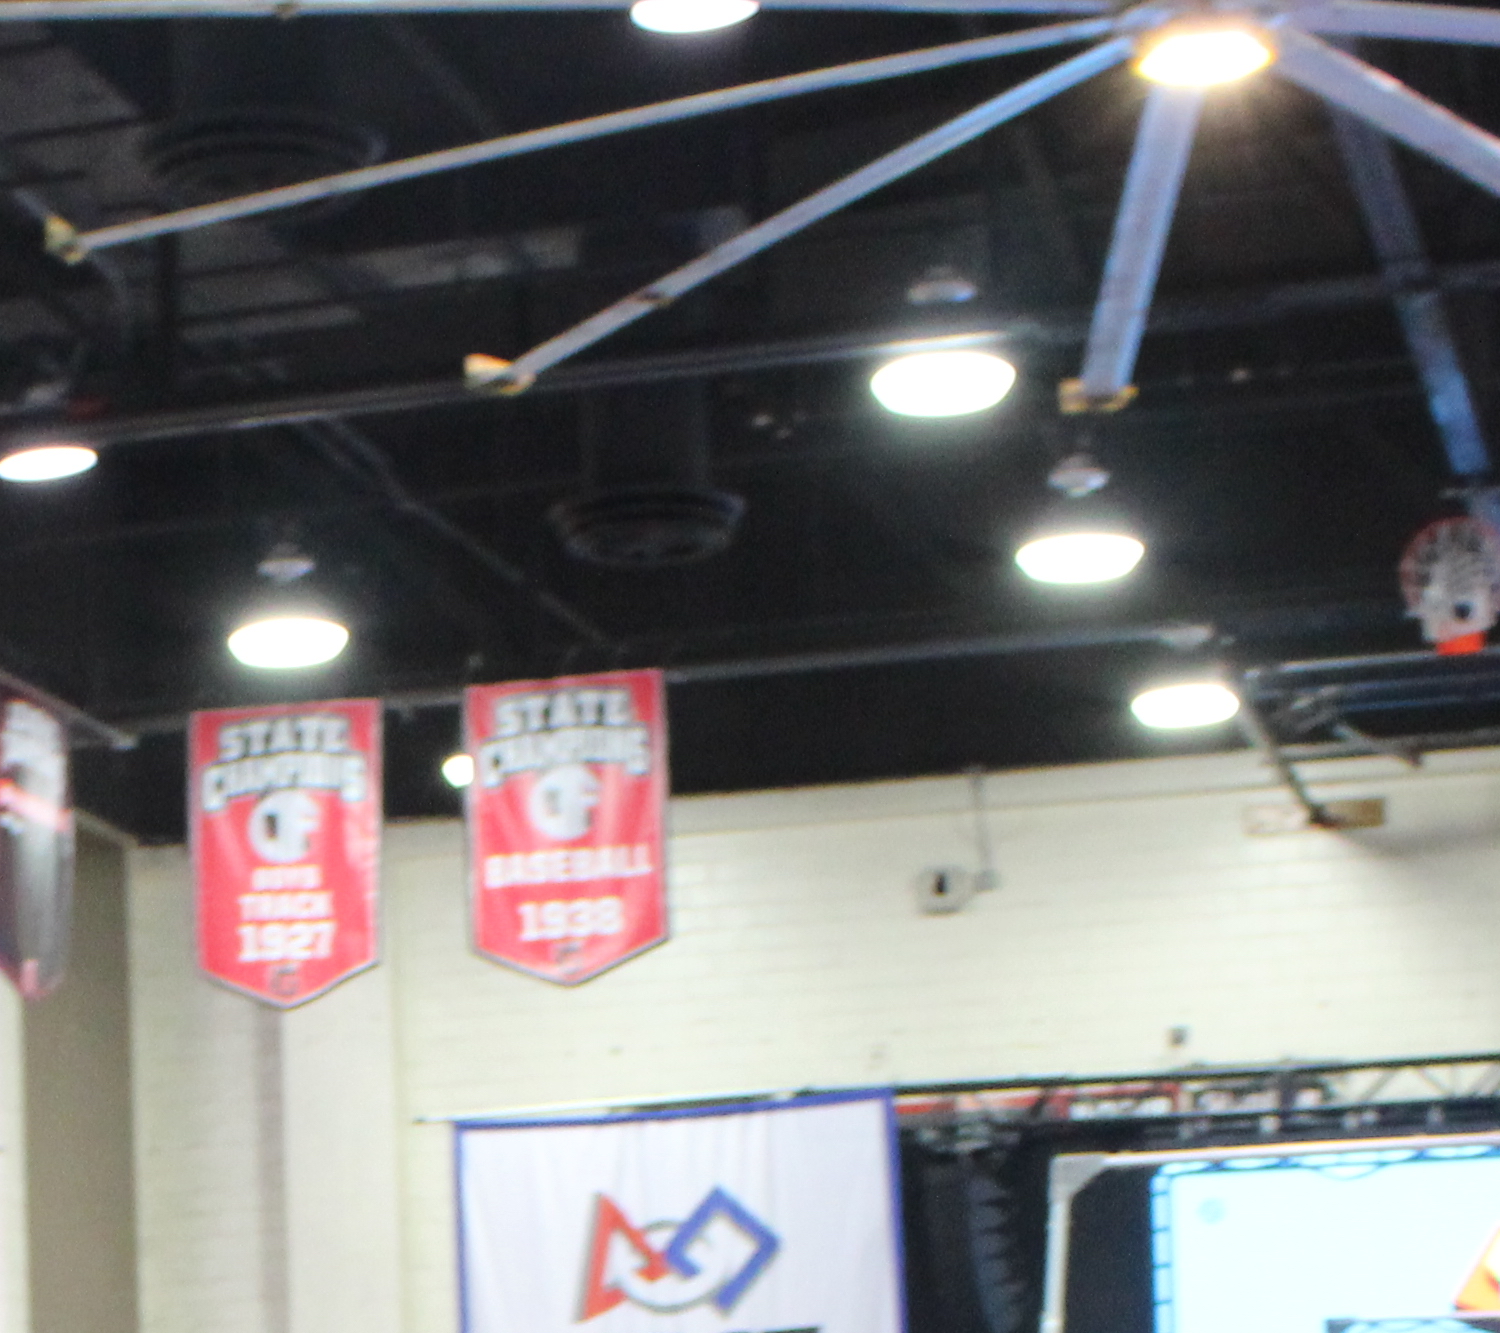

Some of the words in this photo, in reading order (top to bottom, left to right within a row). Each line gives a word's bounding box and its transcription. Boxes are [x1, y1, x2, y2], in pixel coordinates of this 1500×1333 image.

[494, 690, 632, 735] STATE
[219, 714, 351, 759] STATE
[484, 844, 654, 889] BASEBALL
[237, 893, 333, 921] TRACK
[517, 896, 625, 942] 1938
[236, 922, 337, 963] 1927
